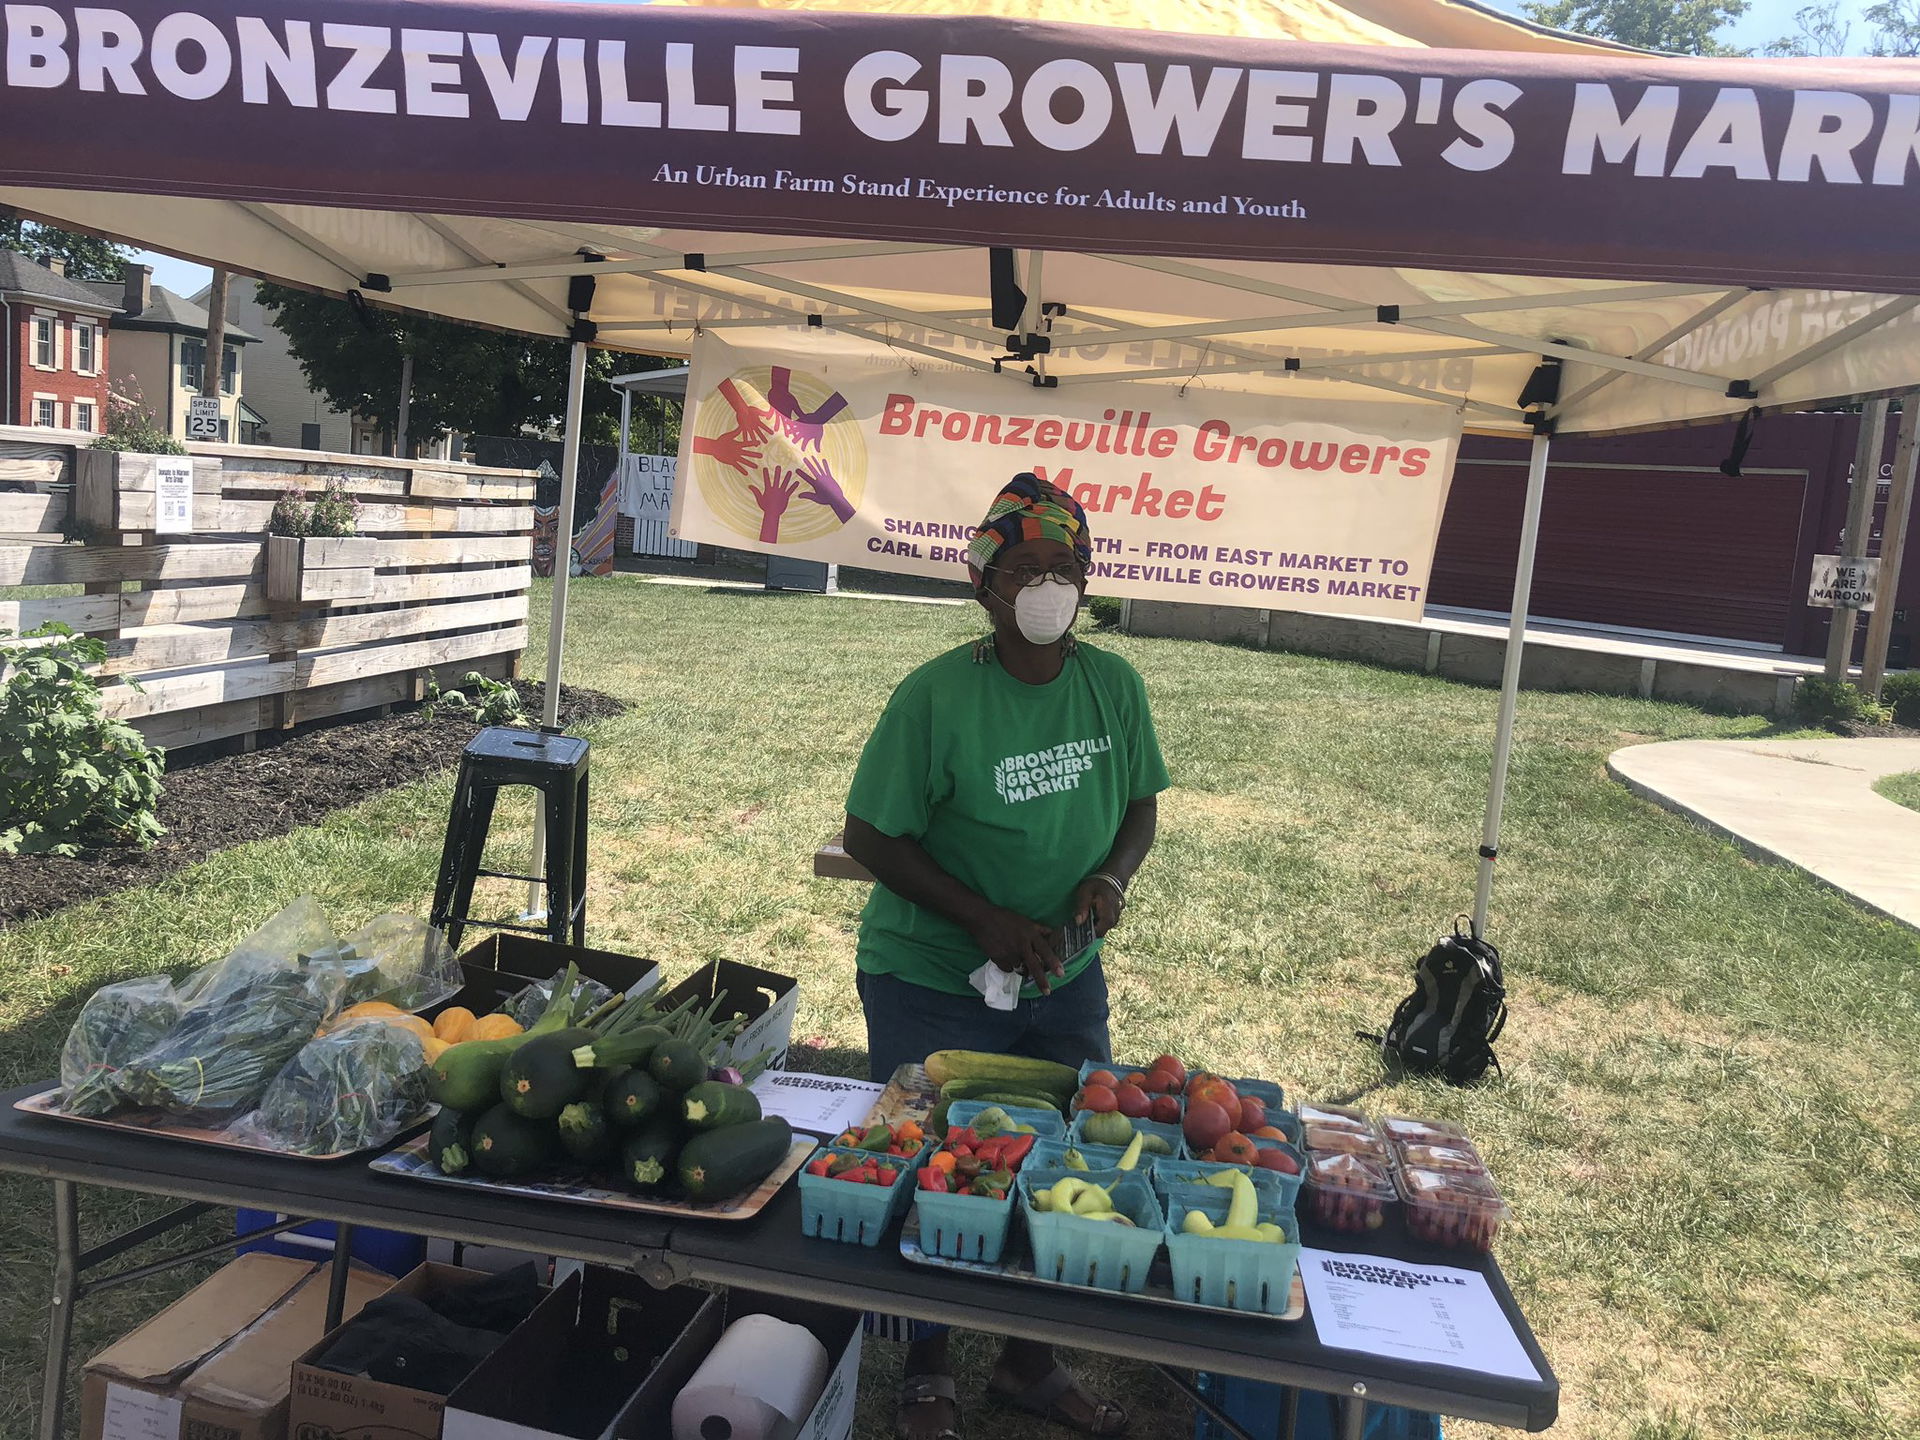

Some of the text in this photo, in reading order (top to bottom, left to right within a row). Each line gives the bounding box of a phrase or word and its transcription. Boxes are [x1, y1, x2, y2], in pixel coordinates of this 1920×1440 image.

[5, 4, 801, 136] BRONZEVILLE
[843, 50, 1524, 172] GROWER'S
[652, 163, 1307, 219] An Urban Farm Stand Experience for Adults and Youth
[193, 400, 218, 409] SPEED
[195, 409, 216, 417] LIMIT
[192, 417, 218, 434] 25
[879, 393, 1431, 477] Bronzeville Growers
[653, 475, 676, 491] LI
[640, 492, 673, 511] MA
[884, 518, 977, 541] SHARING
[1146, 542, 1208, 561] FROM
[1215, 547, 1273, 567] EAST
[1279, 552, 1373, 574] MARKET
[1379, 559, 1409, 576] TO
[867, 537, 923, 559] CARL
[1208, 570, 1320, 594] GROWERS
[1327, 580, 1421, 602] MARKET
[1835, 566, 1857, 578] WE
[1830, 578, 1857, 590] ARE
[1813, 589, 1871, 602] MAROON
[1006, 755, 1093, 788] GROWERS
[1006, 773, 1081, 804] MARKET
[1332, 1260, 1467, 1286] BRONZEVILLE
[1334, 1266, 1431, 1287] GROWERS
[1336, 1271, 1415, 1290] MARKET
